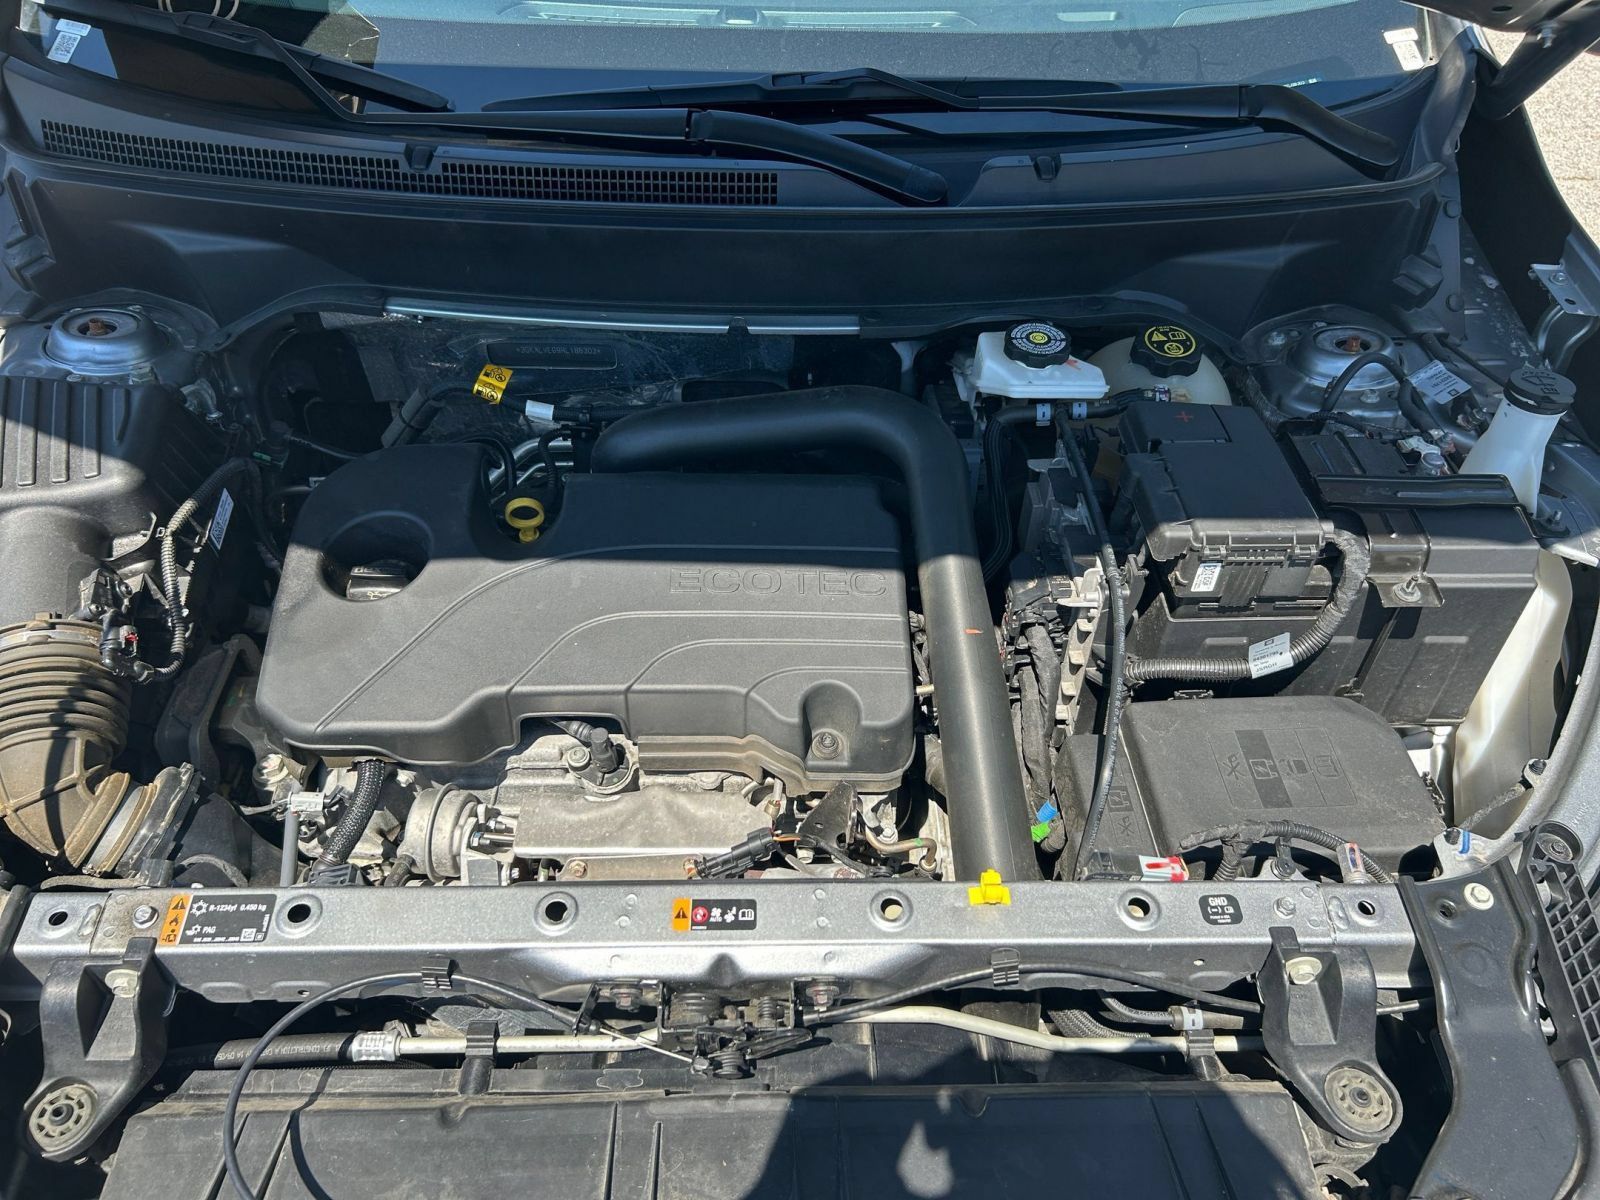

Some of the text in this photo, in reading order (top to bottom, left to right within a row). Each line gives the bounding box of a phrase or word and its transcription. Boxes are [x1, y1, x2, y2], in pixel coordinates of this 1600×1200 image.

[669, 567, 887, 597] ECOTEC
[1208, 897, 1227, 906] GND
[208, 904, 238, 912] R-1234yf
